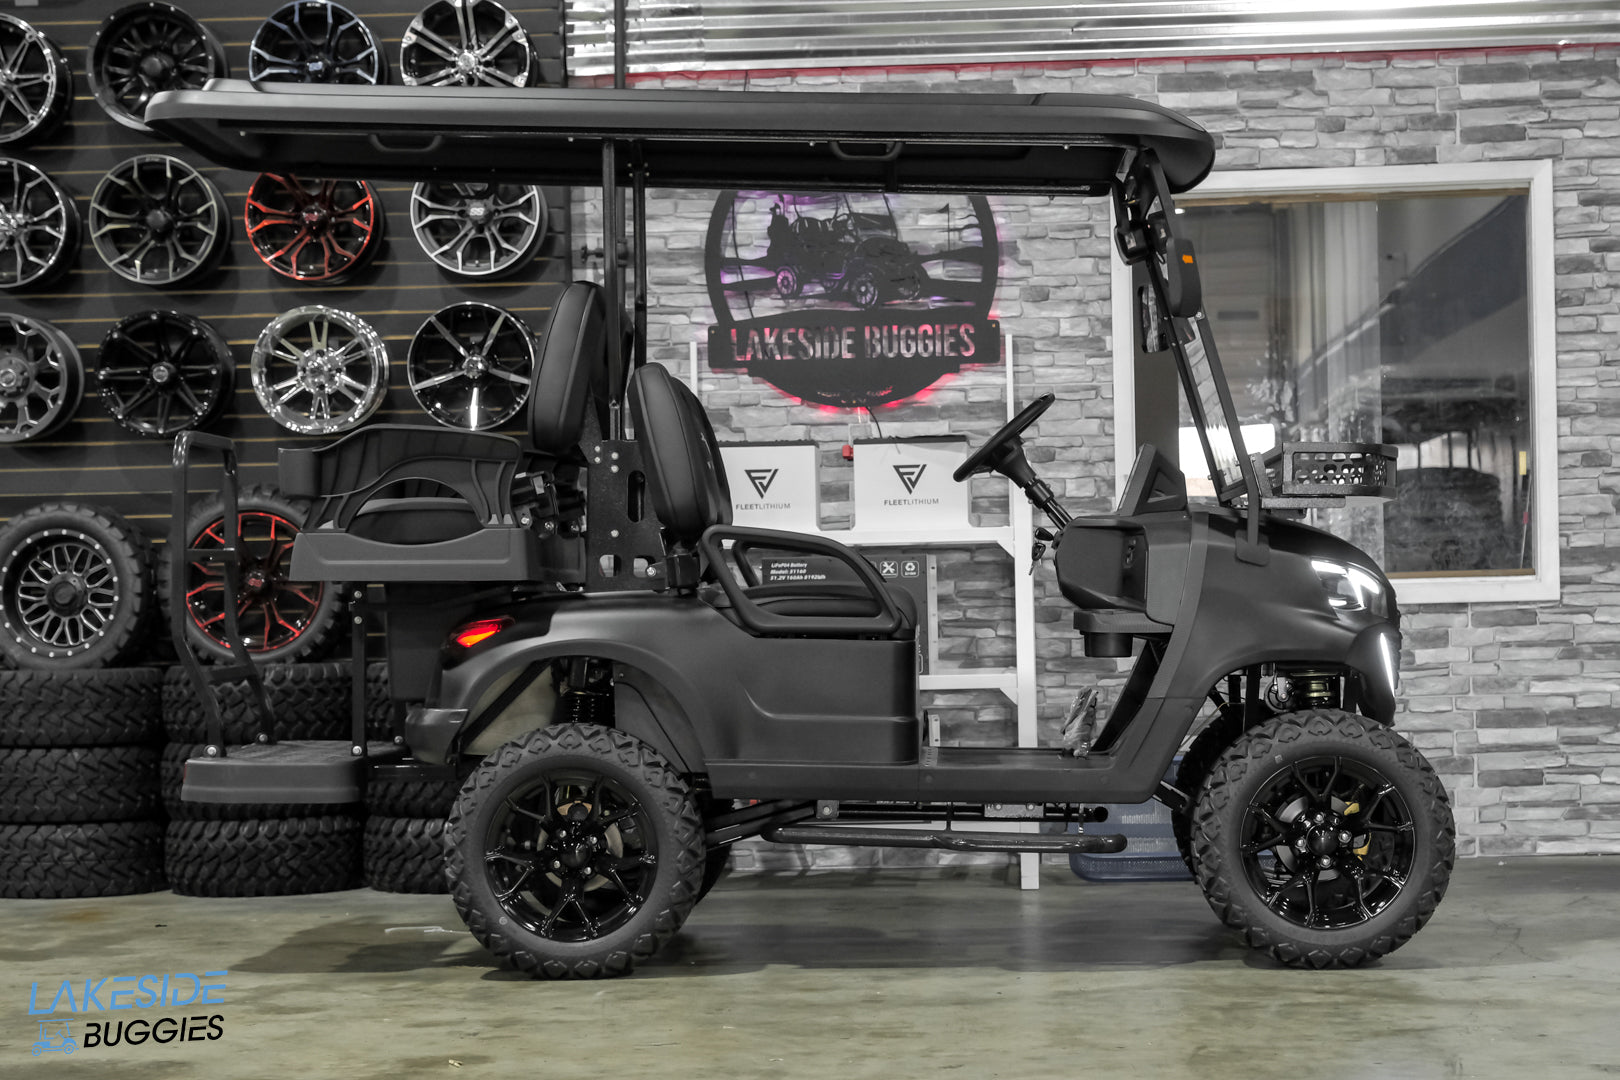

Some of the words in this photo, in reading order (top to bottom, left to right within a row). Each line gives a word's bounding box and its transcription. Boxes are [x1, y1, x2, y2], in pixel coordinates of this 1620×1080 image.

[730, 325, 856, 361] LAKESIDE
[864, 323, 975, 359] BUGGIES
[883, 498, 939, 506] FLEETLITHIUM
[735, 503, 791, 511] FLEETLITHIUM
